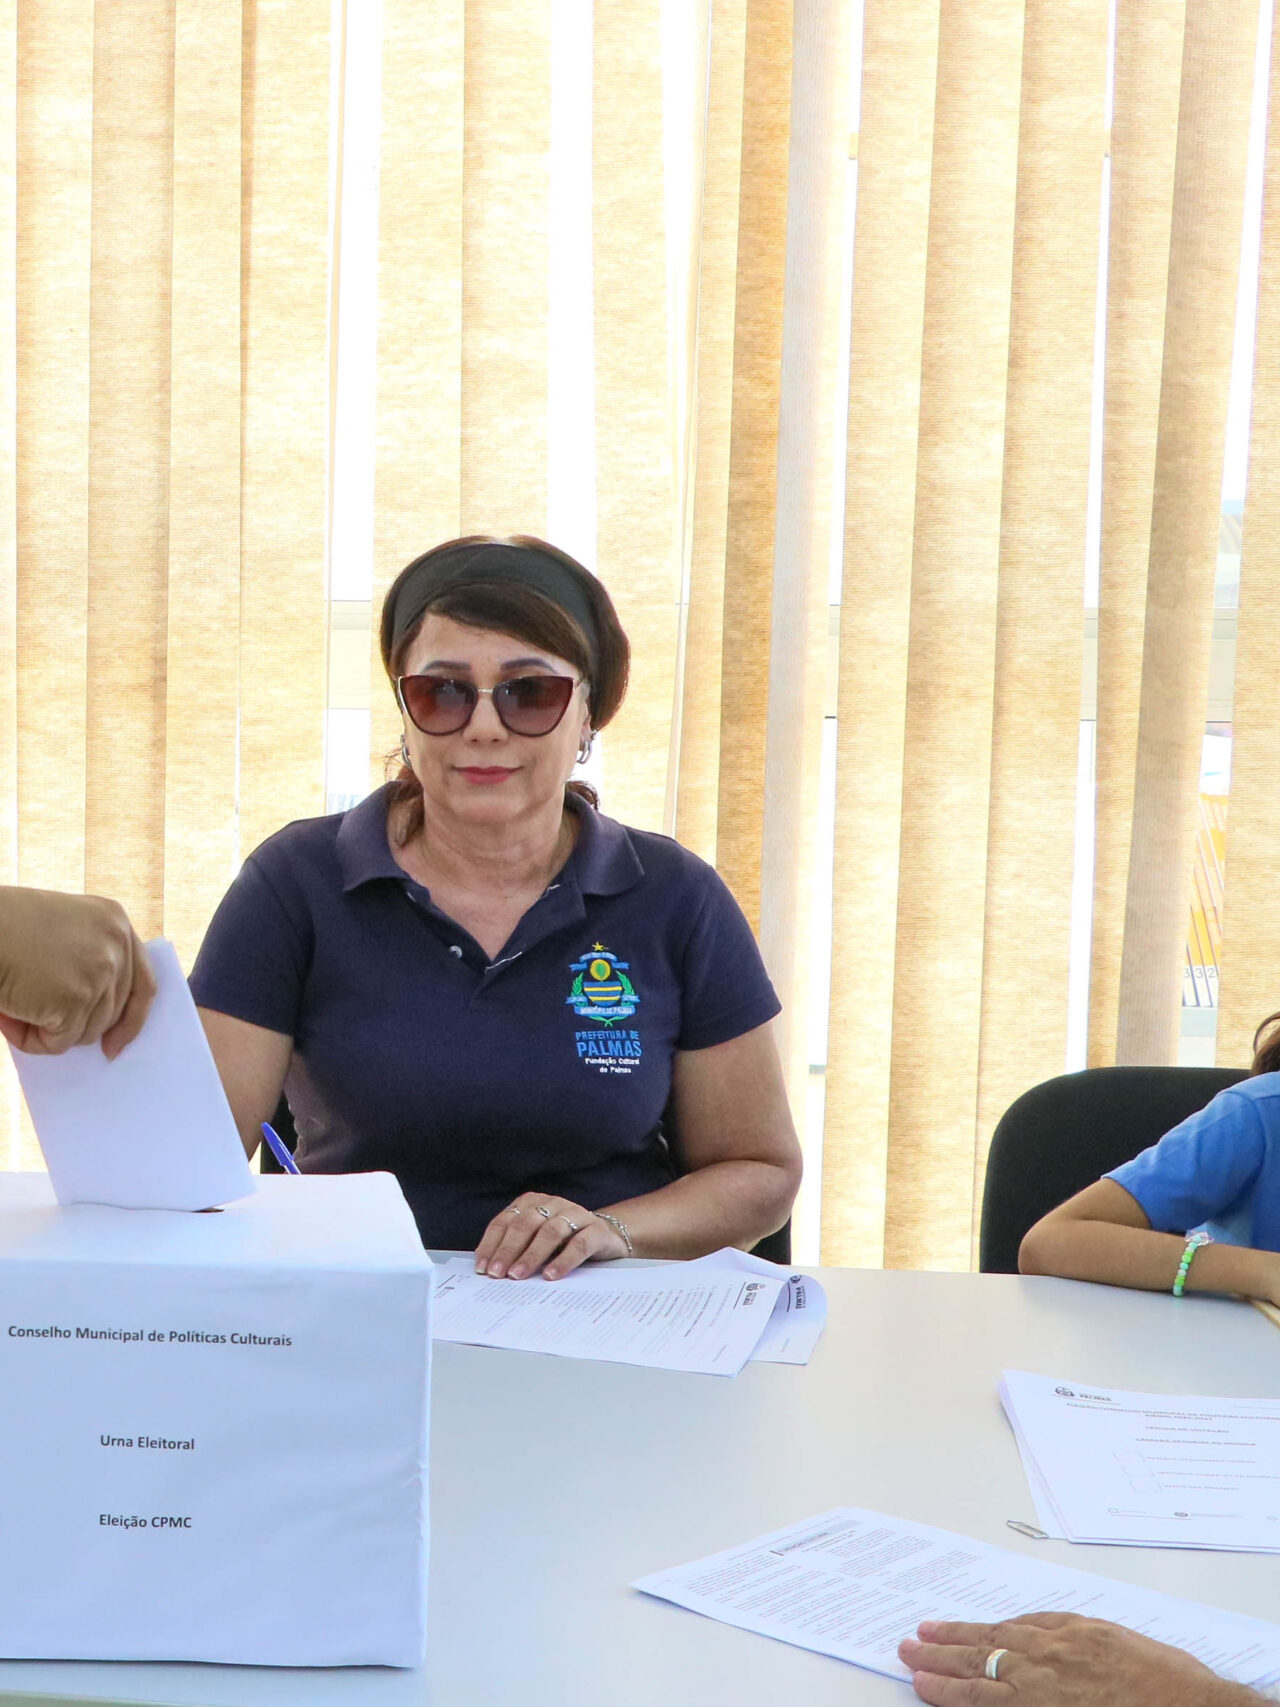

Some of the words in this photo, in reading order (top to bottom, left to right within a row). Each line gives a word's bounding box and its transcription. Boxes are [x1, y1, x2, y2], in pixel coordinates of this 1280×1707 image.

[575, 1030, 627, 1040] PREFEITURA
[629, 1030, 639, 1040] DE
[576, 1040, 642, 1057] PALMAS
[7, 1325, 72, 1339] Conselho
[75, 1327, 144, 1344] Municipal
[147, 1329, 165, 1343] de
[168, 1330, 227, 1345] Políticas
[229, 1333, 293, 1347] Culturais
[100, 1434, 134, 1448] Urna
[137, 1436, 195, 1451] Eleitoral
[99, 1513, 148, 1530] Eleição
[150, 1516, 193, 1529] CPMC
